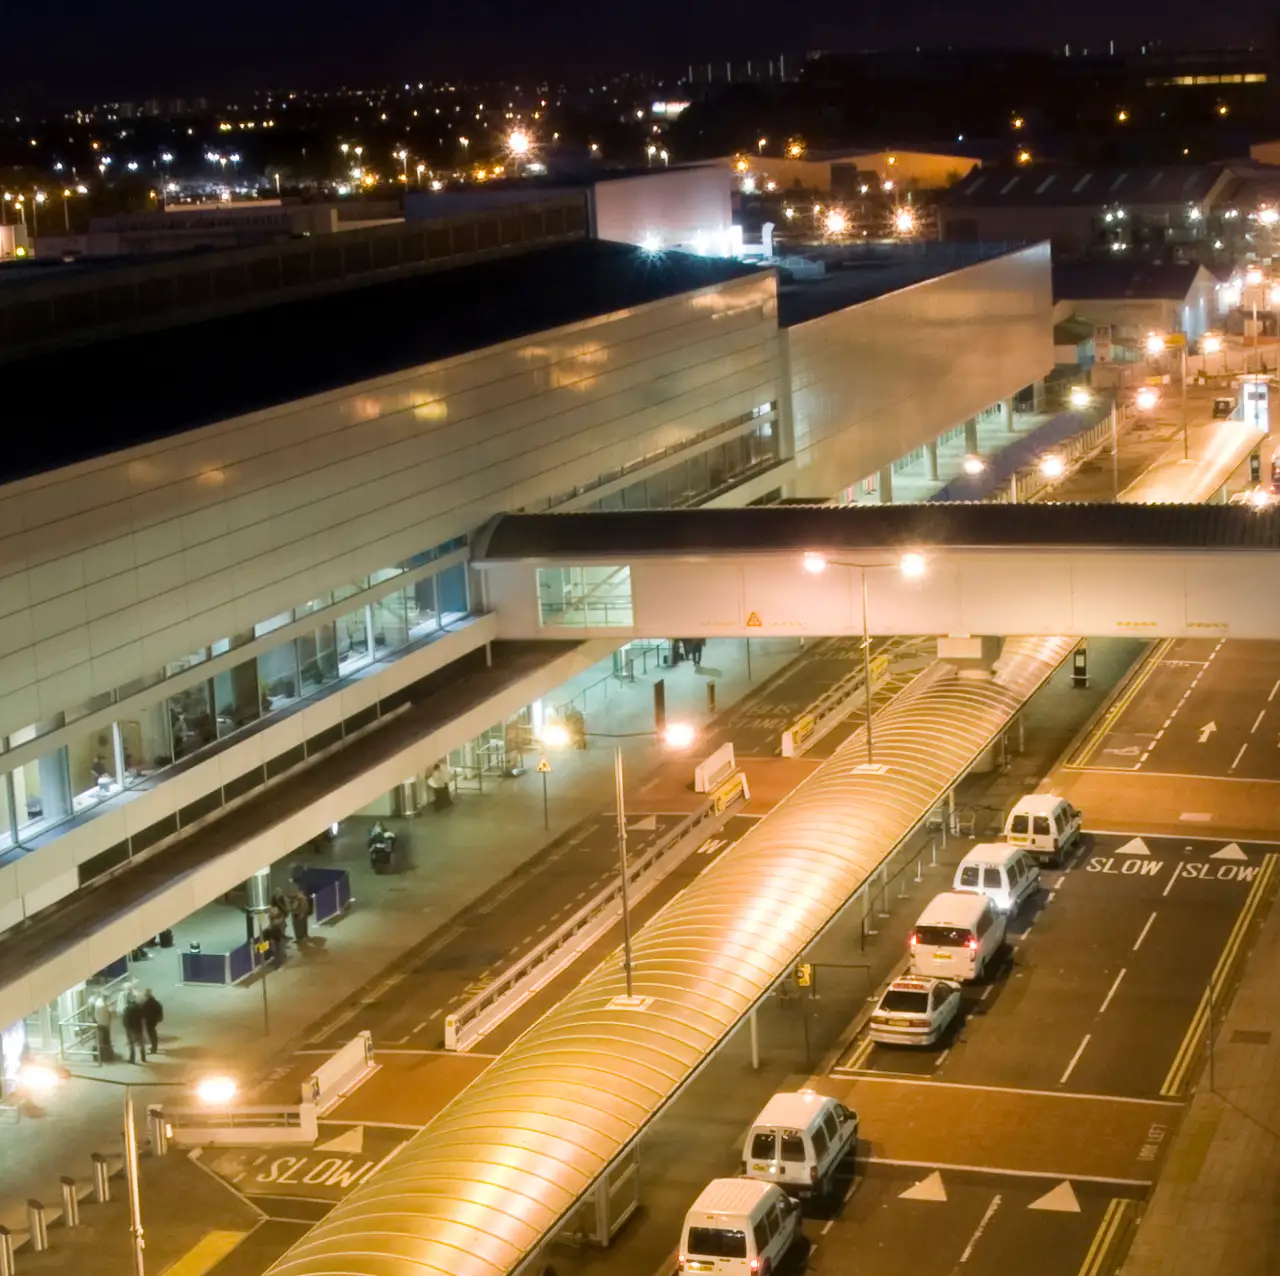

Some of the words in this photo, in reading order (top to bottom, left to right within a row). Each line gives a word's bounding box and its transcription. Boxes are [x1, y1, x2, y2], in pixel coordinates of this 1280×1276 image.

[1087, 857, 1163, 876] SLOW
[1182, 863, 1261, 883] SLOW
[256, 1155, 374, 1188] SLOW
